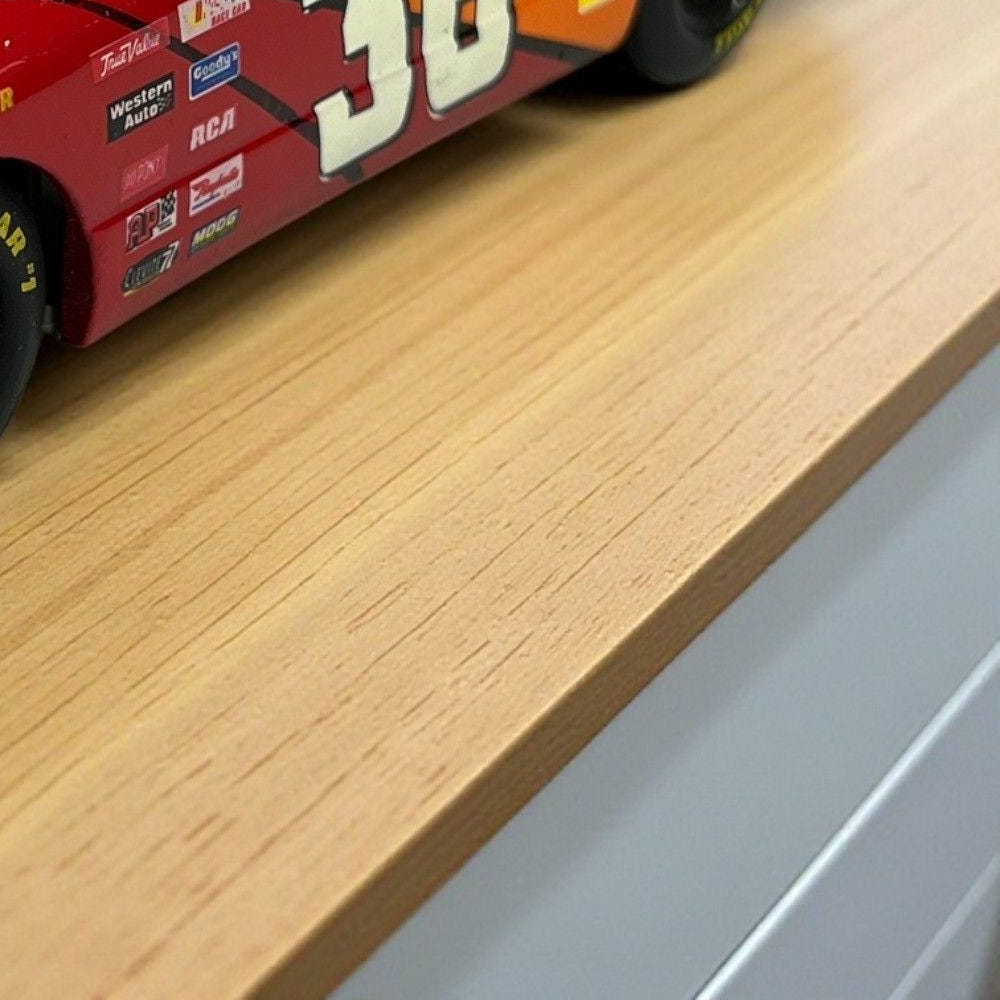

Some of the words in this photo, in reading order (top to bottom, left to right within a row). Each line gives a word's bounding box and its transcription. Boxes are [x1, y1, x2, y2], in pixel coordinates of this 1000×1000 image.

[110, 79, 173, 120] Western
[123, 102, 159, 131] Auto
[189, 106, 236, 152] RCA
